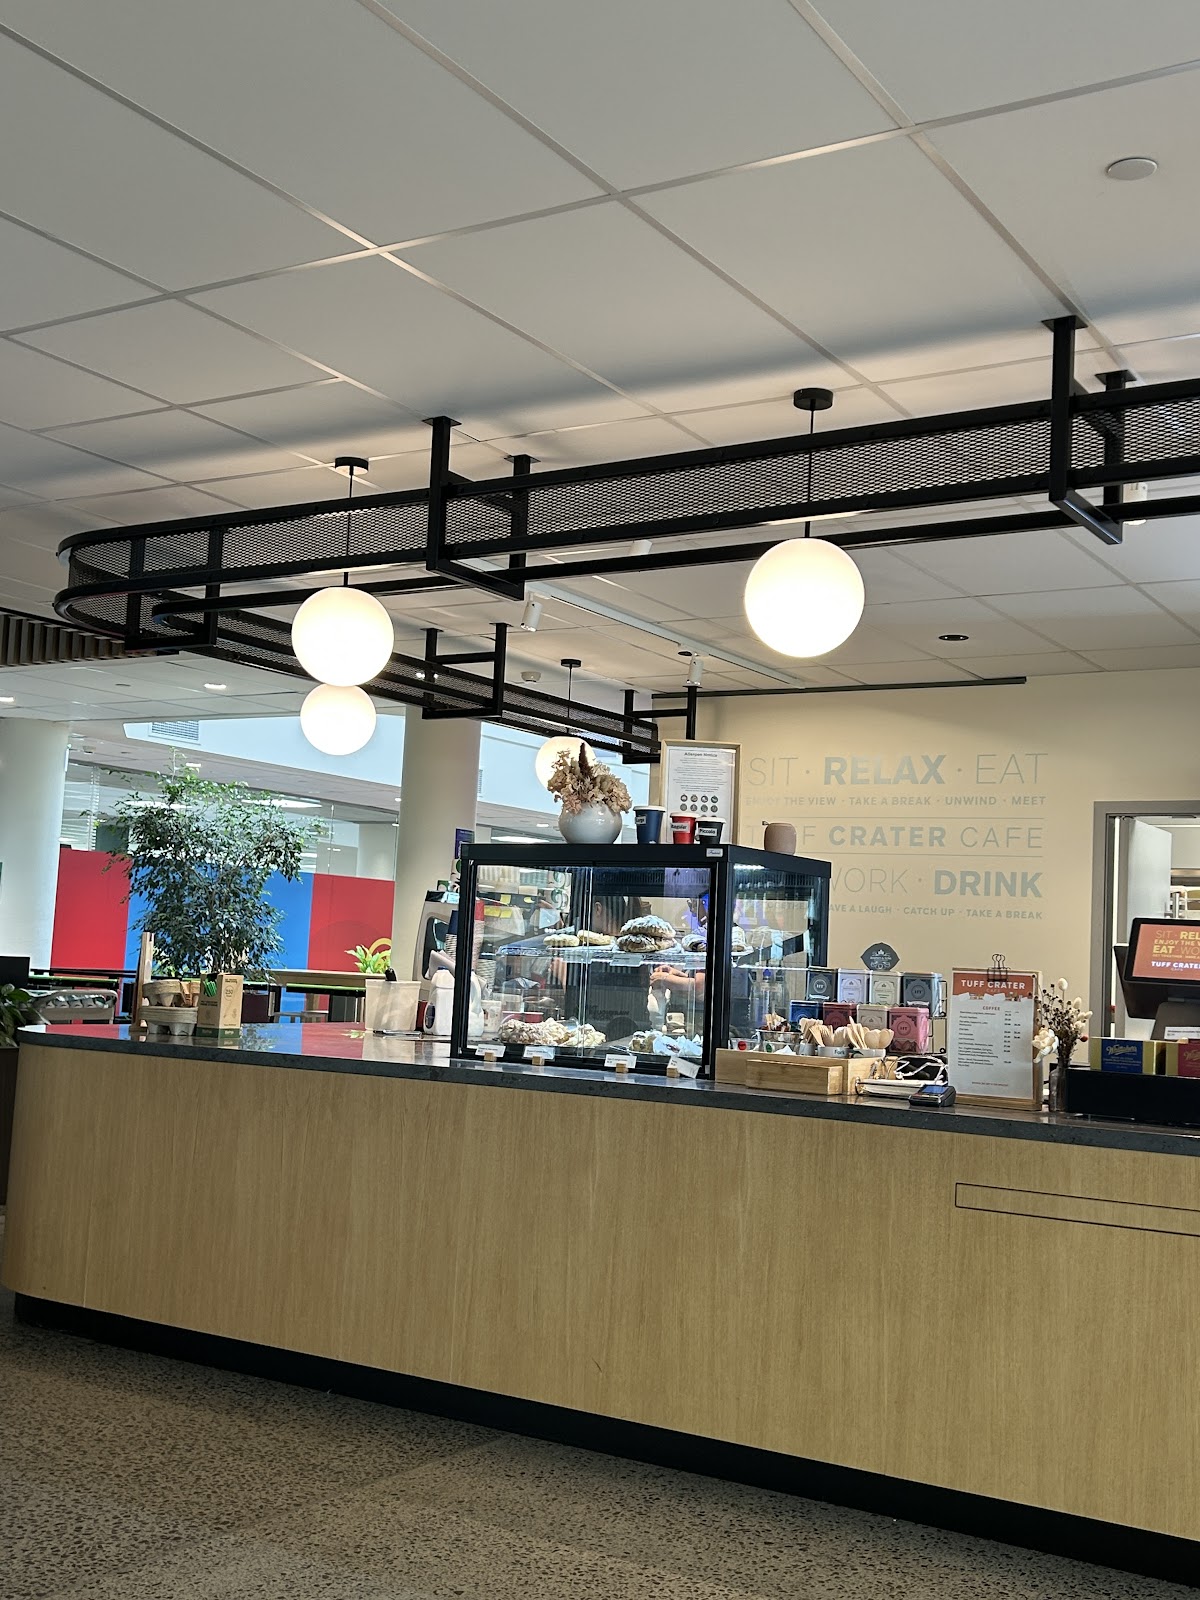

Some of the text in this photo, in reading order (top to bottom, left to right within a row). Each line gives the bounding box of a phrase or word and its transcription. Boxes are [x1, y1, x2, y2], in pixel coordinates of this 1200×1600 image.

[748, 757, 799, 786] SIT
[823, 754, 947, 786] RELAX
[975, 753, 1049, 785] EAT
[784, 796, 805, 806] THE
[808, 796, 836, 806] VIEW
[849, 796, 877, 806] TAKE
[880, 796, 888, 806] A
[891, 796, 931, 806] BREAK
[945, 796, 997, 806] UNWIND
[1011, 795, 1046, 805] MEET
[828, 825, 946, 847] CRATER
[959, 826, 1043, 848] CAFE
[934, 869, 1043, 898] DRINK
[829, 904, 847, 912] AVE
[849, 904, 856, 912] A
[858, 905, 892, 914] LAUGH
[903, 906, 937, 916] CATCH
[940, 907, 955, 917] UP
[966, 908, 993, 918] TAKE
[994, 909, 1003, 918] A
[1005, 909, 1043, 920] BREAK
[1155, 930, 1200, 940] SIT REL
[1152, 945, 1200, 956] EAT WO
[961, 980, 1026, 990] TUFF CRATER
